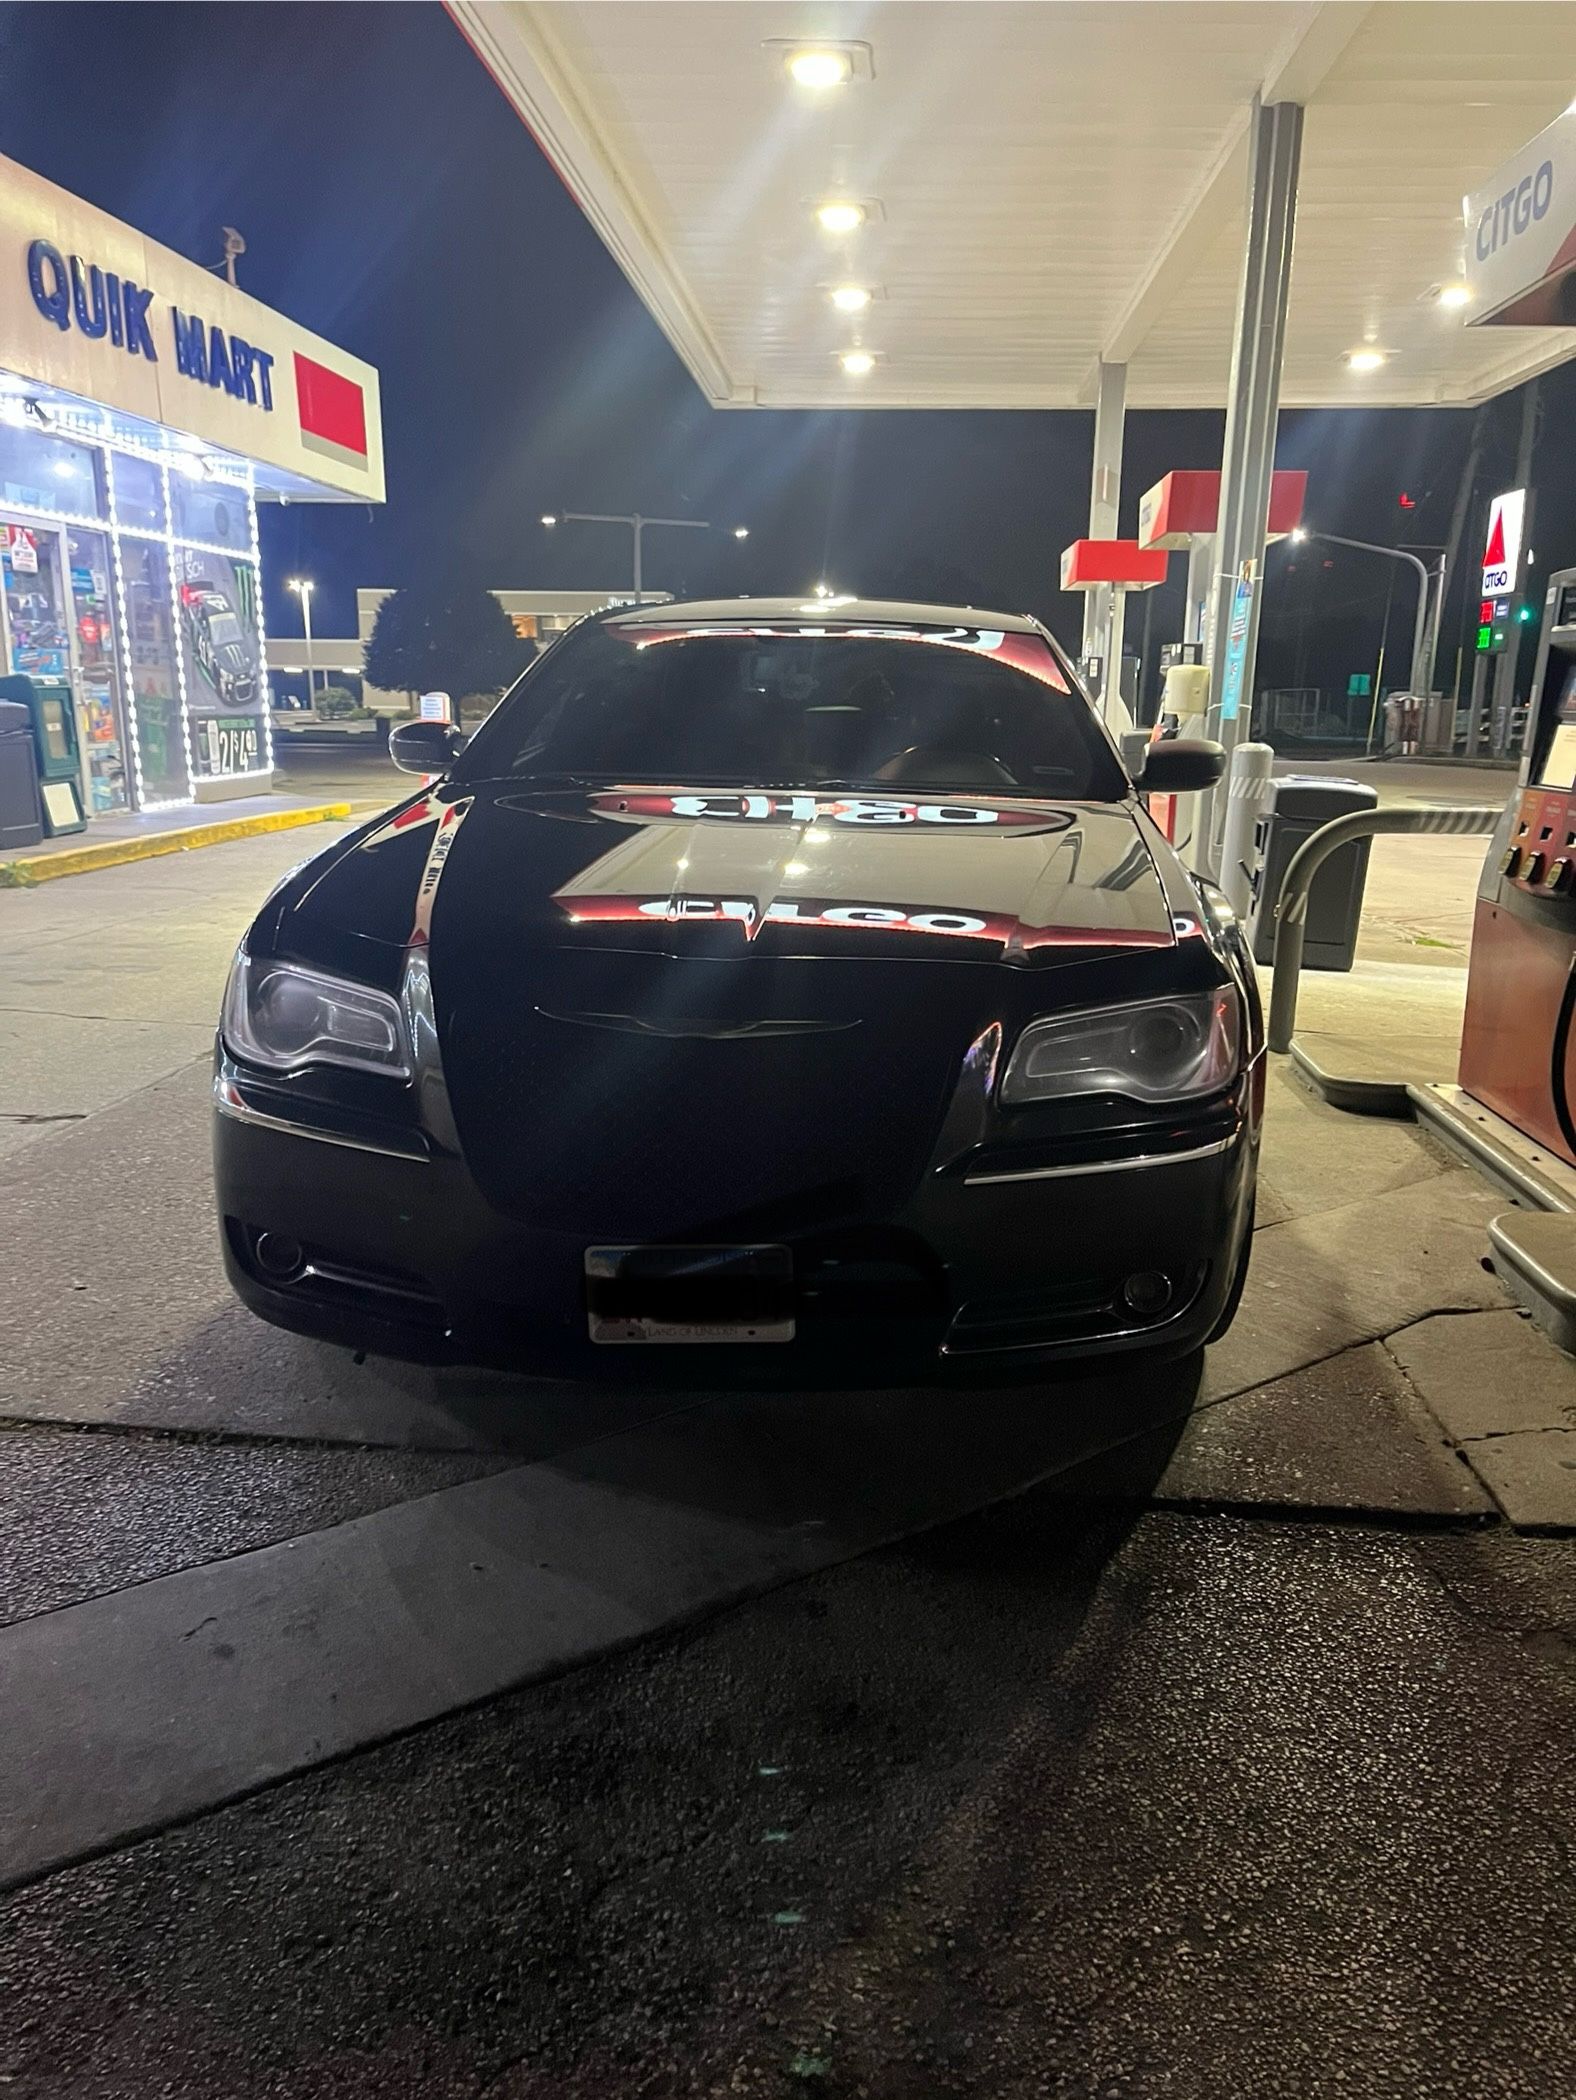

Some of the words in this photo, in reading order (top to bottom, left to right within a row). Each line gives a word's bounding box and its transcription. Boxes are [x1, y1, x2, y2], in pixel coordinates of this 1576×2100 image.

[1476, 160, 1553, 262] CITGO
[27, 238, 158, 363] QUIK
[172, 306, 274, 412] MART
[1484, 570, 1508, 590] CITGO
